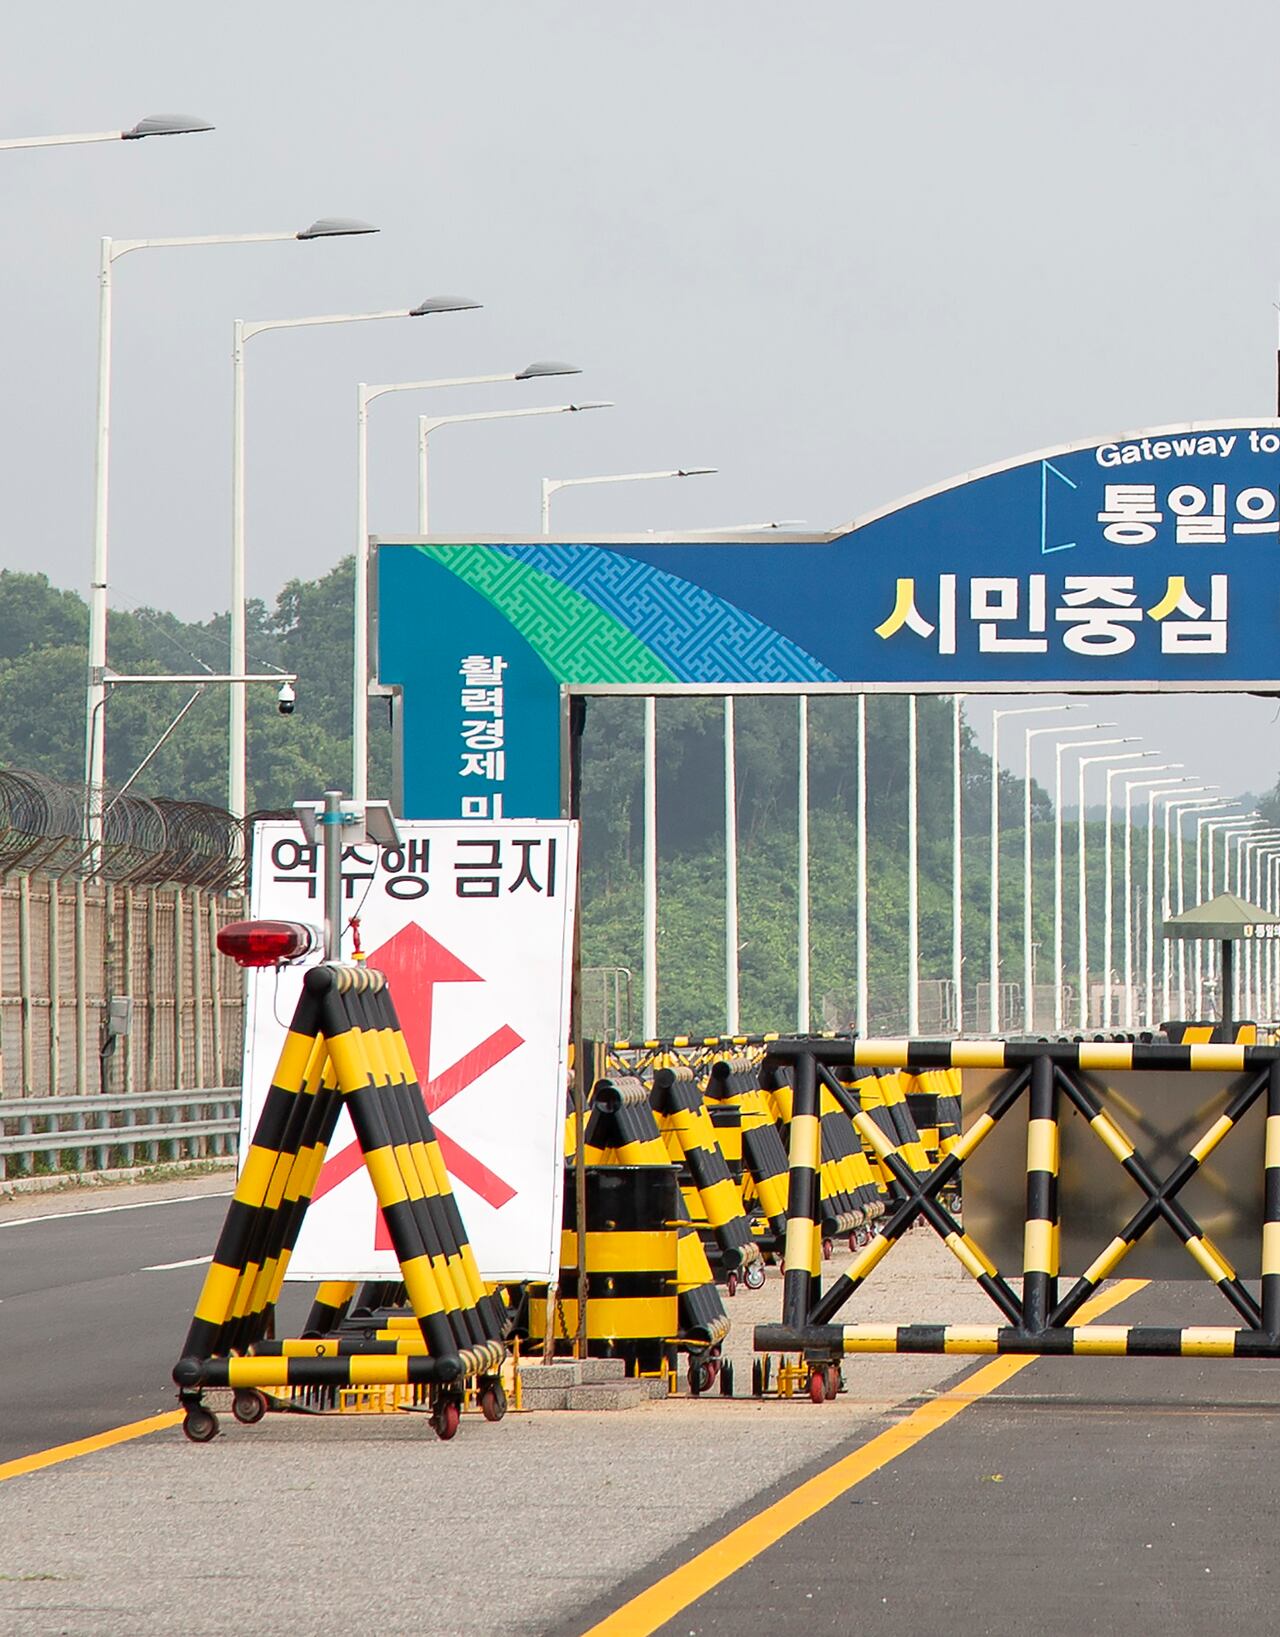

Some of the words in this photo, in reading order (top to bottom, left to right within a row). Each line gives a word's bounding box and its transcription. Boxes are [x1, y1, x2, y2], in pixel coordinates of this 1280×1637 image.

[1095, 434, 1238, 468] Gateway
[1248, 431, 1280, 453] to
[875, 575, 1228, 656] 시민중심
[459, 655, 508, 781] 활력경제
[454, 838, 557, 898] 금지
